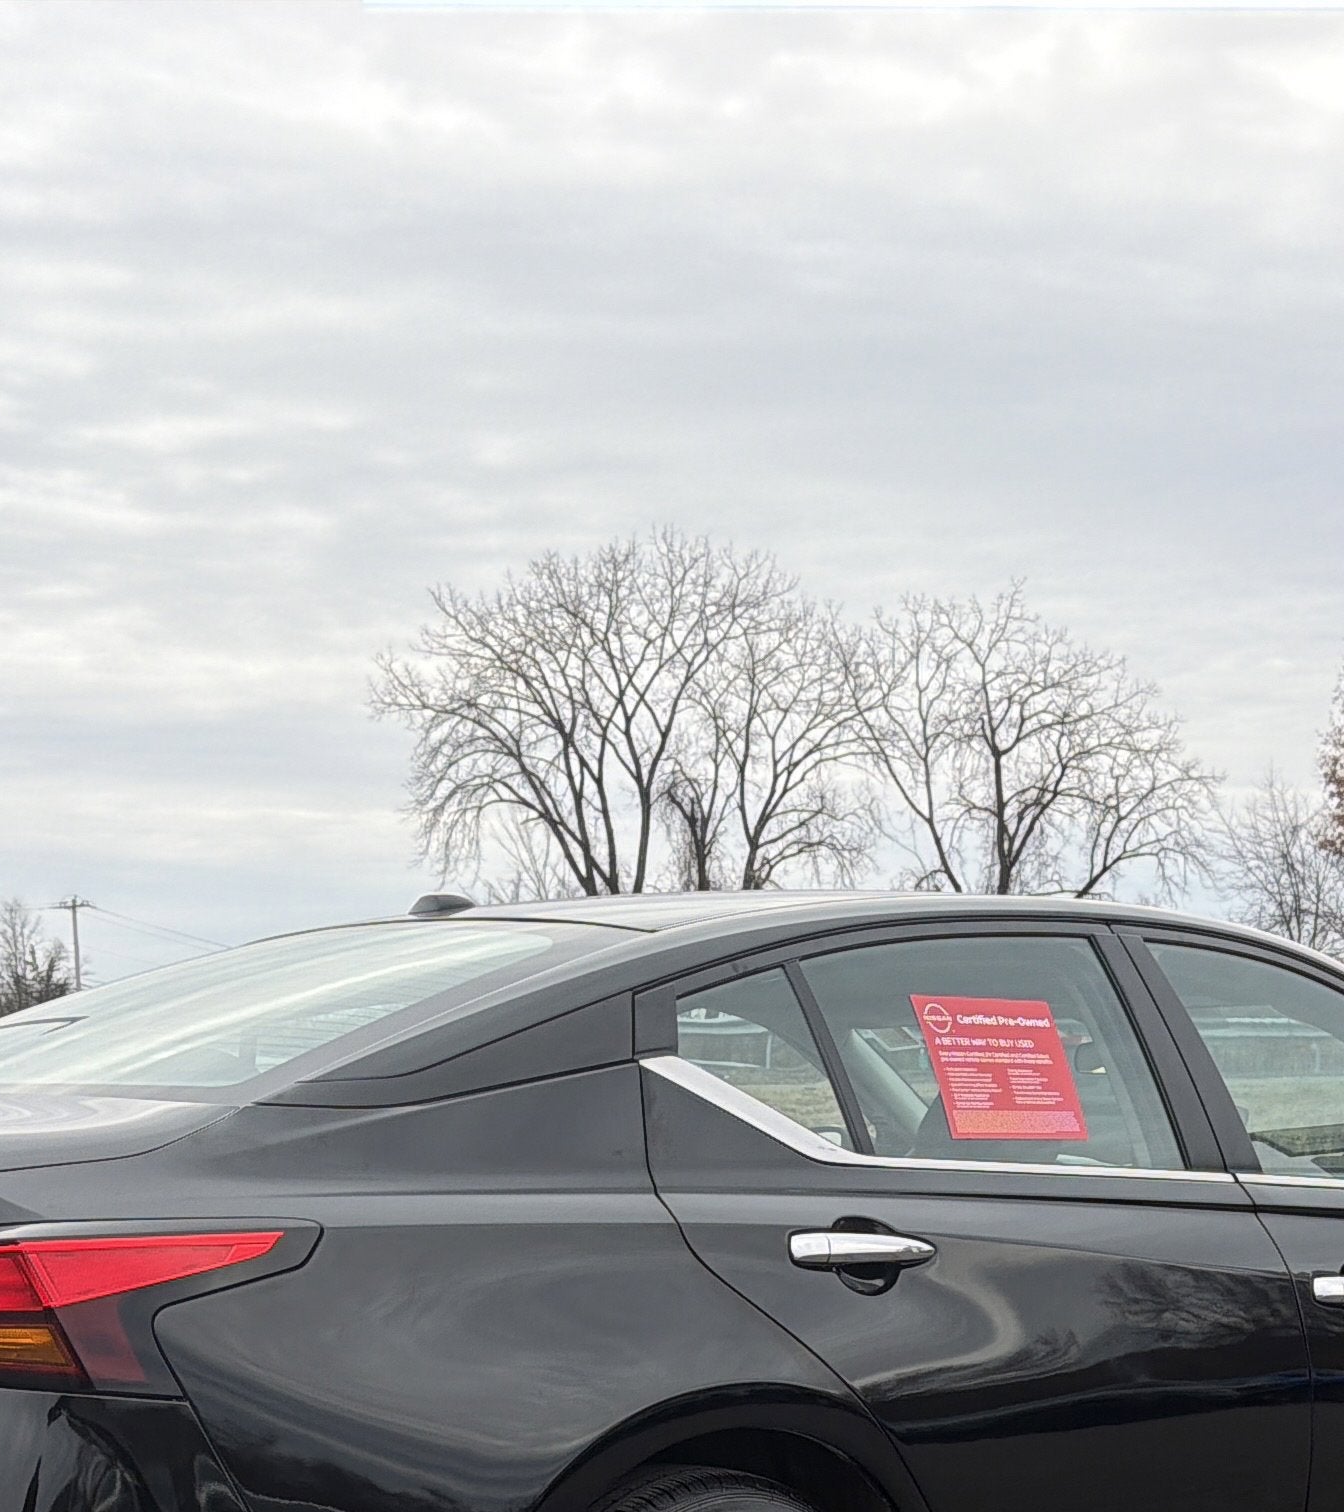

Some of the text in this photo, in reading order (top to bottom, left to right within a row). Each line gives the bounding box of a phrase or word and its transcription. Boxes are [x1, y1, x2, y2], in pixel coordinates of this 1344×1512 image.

[956, 1014, 1050, 1028] Certified Pre-Owned
[942, 1036, 970, 1047] BETTER
[987, 1038, 999, 1048] TO
